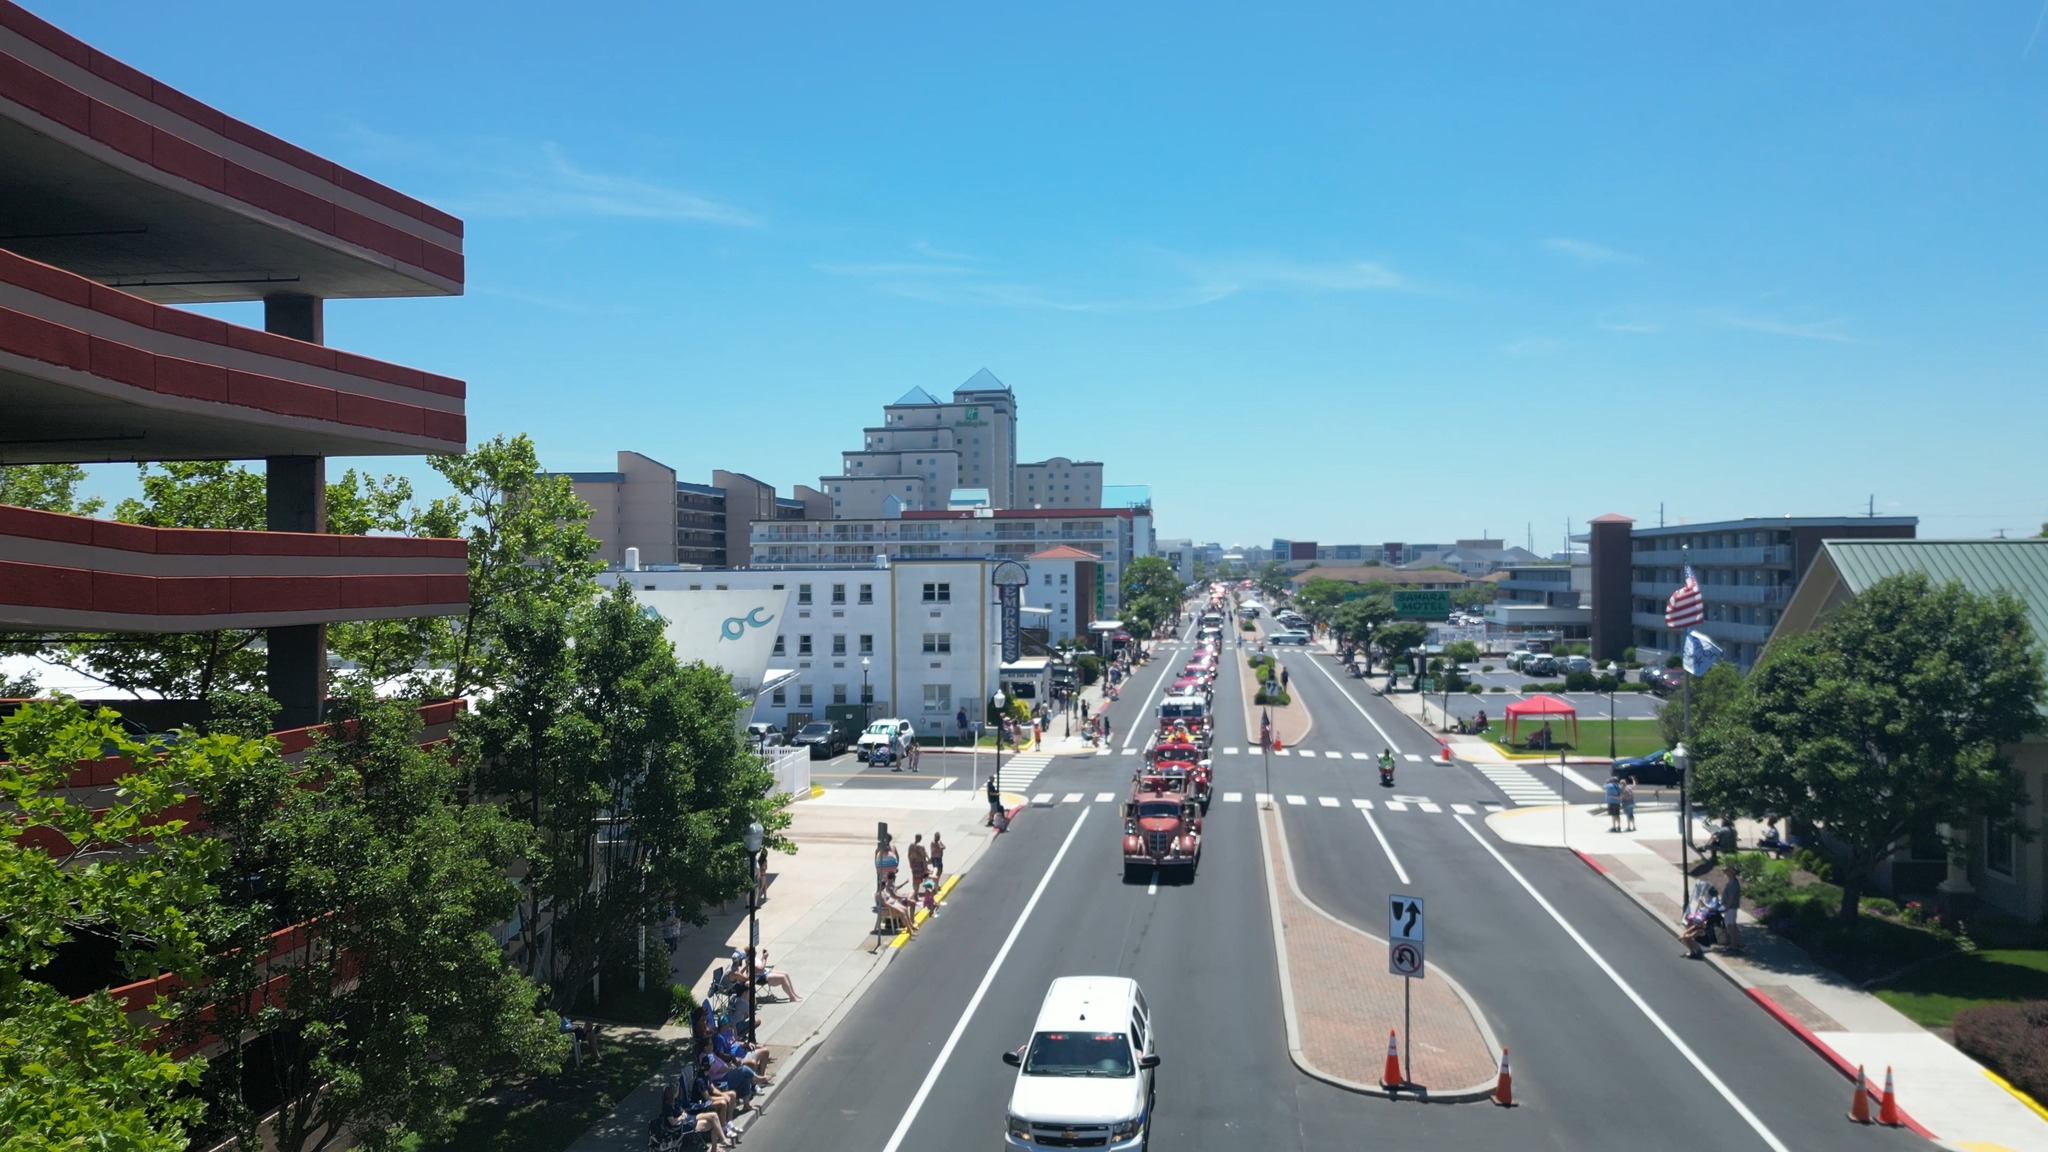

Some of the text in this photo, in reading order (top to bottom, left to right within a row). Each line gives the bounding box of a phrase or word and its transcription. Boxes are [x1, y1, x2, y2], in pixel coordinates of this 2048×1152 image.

[1398, 593, 1446, 602] SAHARA
[1401, 602, 1446, 611] MOTEL
[1003, 585, 1018, 661] EMPRESS
